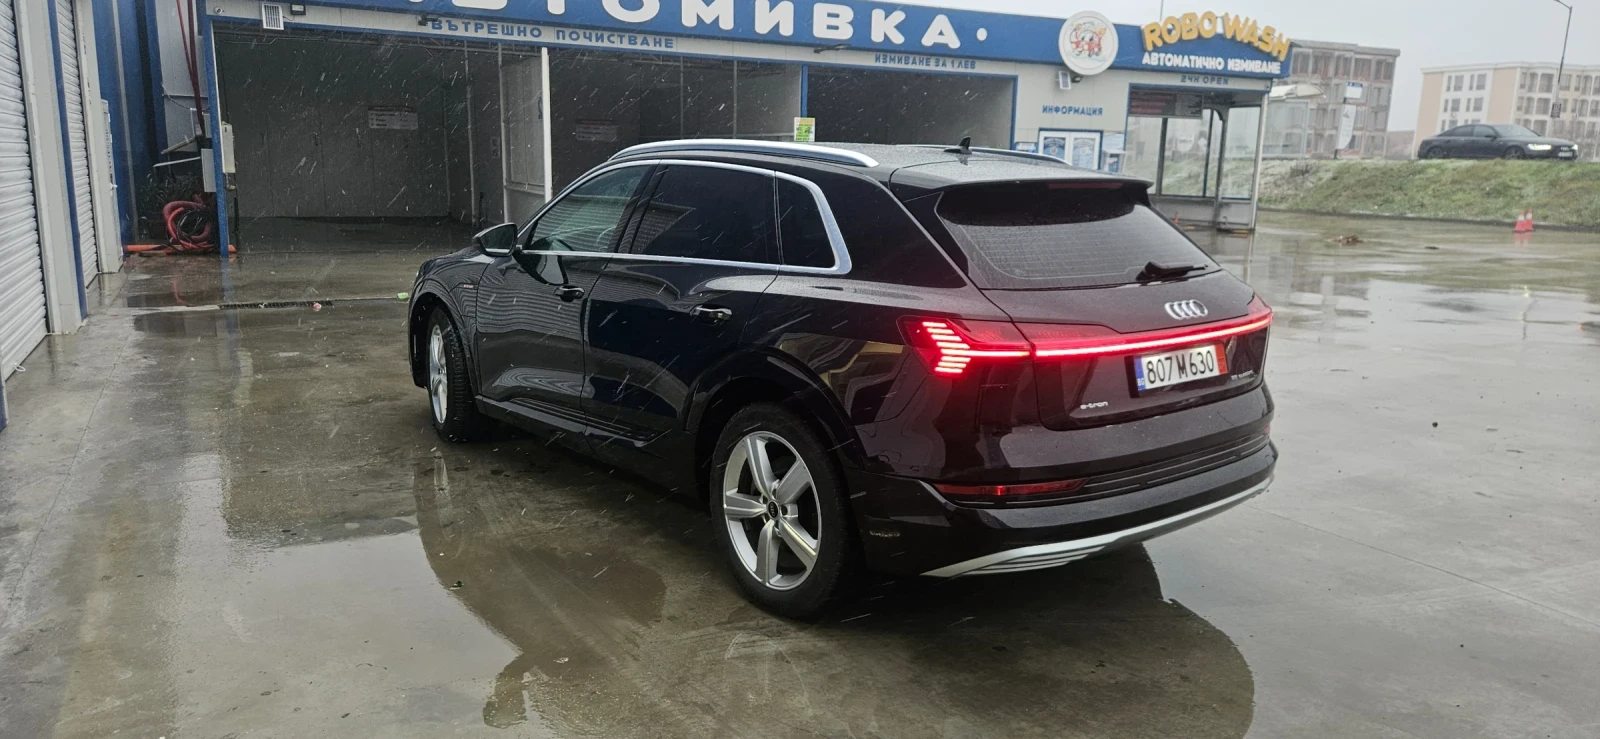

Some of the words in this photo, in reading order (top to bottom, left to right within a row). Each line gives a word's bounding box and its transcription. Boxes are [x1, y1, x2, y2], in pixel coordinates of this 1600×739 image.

[409, 0, 962, 49] ОМИВКА
[431, 19, 542, 38] ВЪТРЕШНО
[556, 29, 674, 49] ПОЧИСТВАНЕ
[1143, 11, 1217, 51] ROBO
[1222, 12, 1291, 61] WASH
[874, 54, 931, 67] ИЗМИВАНЕ
[934, 59, 947, 68] ЗА
[957, 60, 976, 69] ЛЕВ
[1142, 52, 1225, 69] АВТОМАТИЧНО
[1228, 58, 1281, 74] ИЗМИВАНЕ
[1180, 75, 1200, 84] 24H
[1203, 76, 1229, 85] OPEN
[1042, 105, 1103, 116] ИНФОРМАЦИЯ
[1137, 377, 1145, 386] BG
